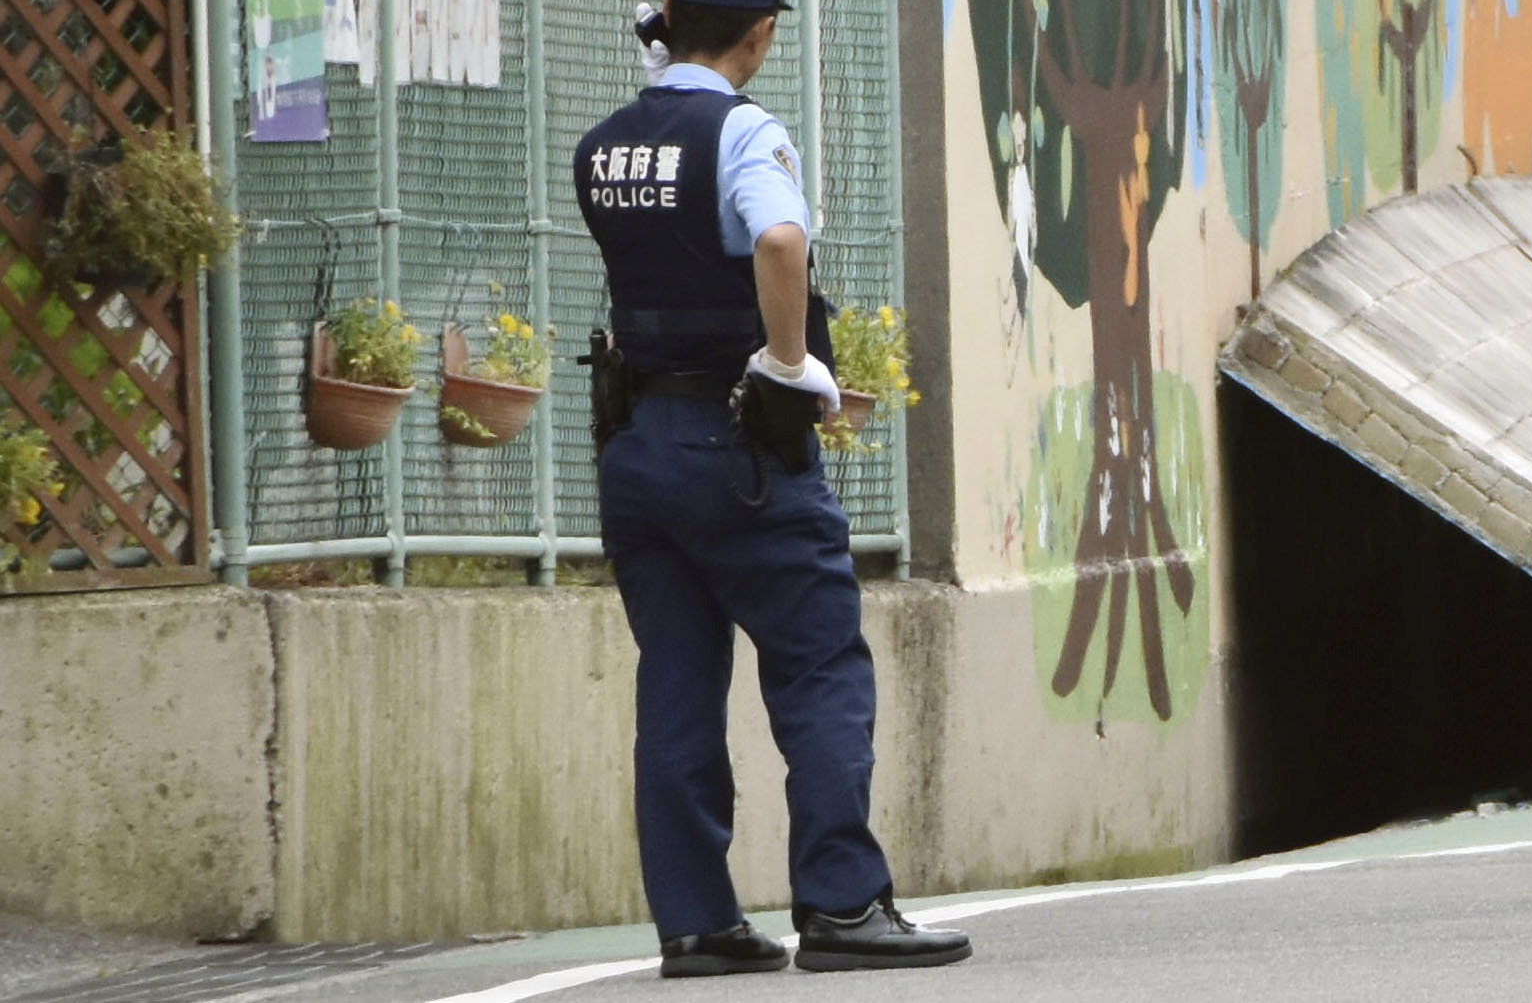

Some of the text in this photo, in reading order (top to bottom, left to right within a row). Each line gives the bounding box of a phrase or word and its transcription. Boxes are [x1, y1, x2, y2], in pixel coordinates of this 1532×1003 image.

[591, 145, 682, 181] 大阪府警
[591, 187, 677, 208] POLICE
